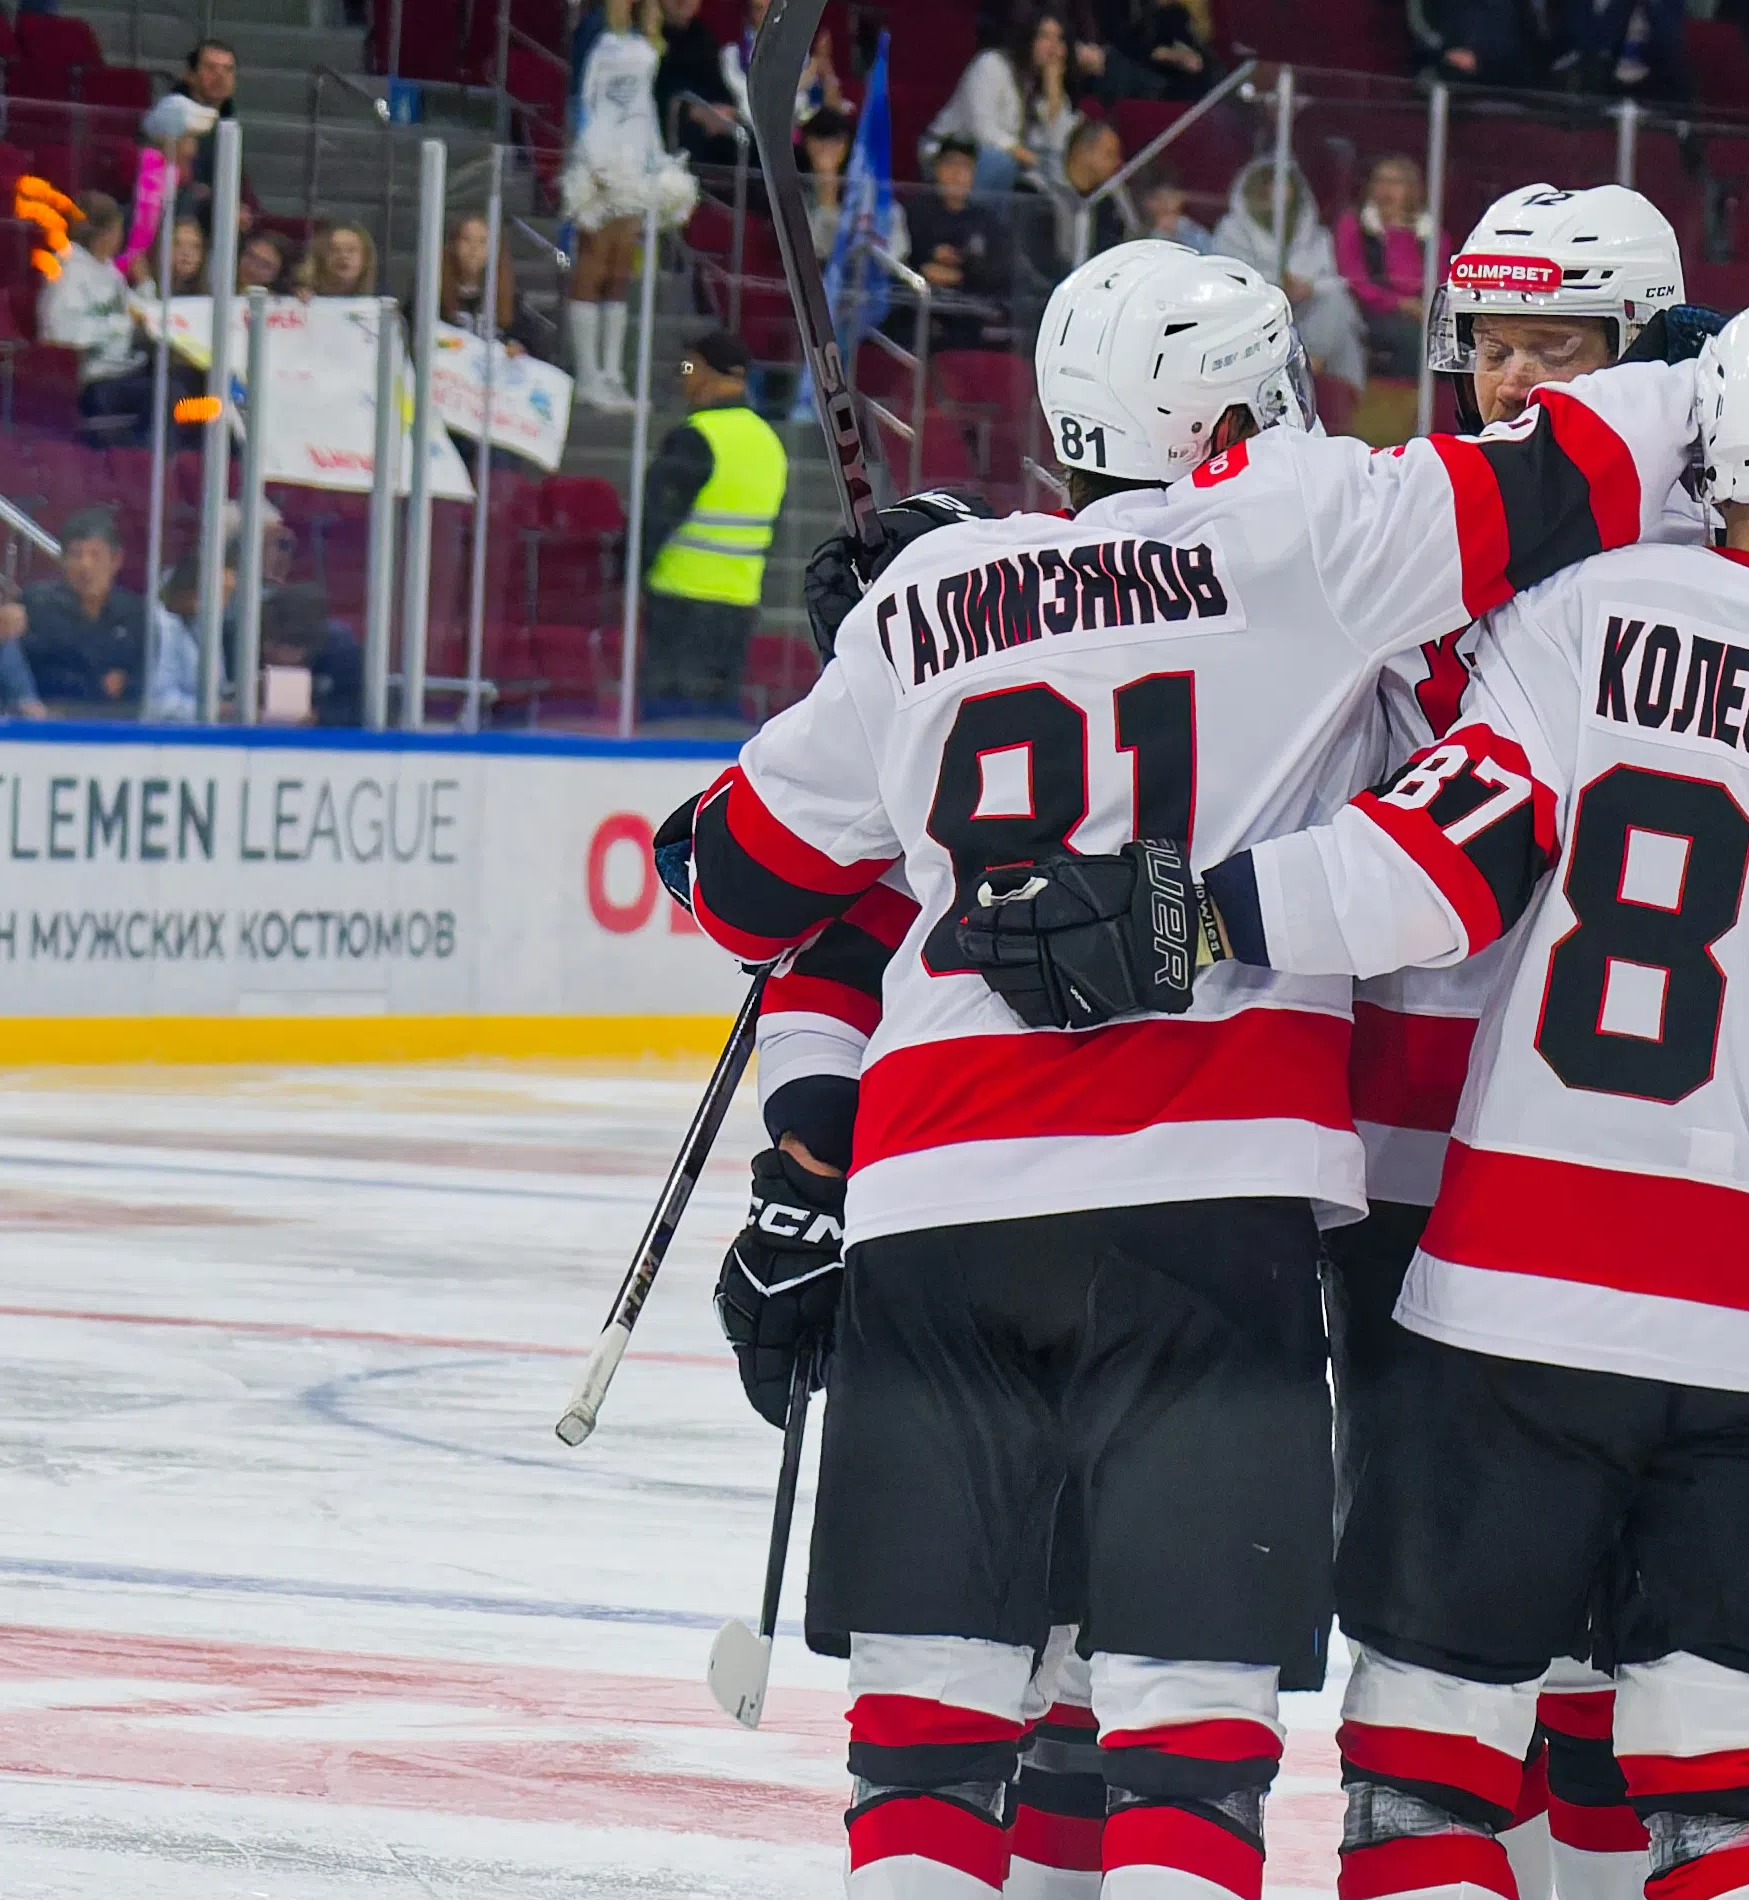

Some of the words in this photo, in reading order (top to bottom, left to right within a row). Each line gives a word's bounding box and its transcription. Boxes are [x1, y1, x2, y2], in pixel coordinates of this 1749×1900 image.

[1455, 262, 1554, 283] OLIMPBET
[1645, 285, 1675, 298] CCM
[1059, 416, 1107, 469] 81
[875, 540, 1229, 696] ГАЛИМЗЯНОВ
[238, 777, 458, 865] LEAGUE
[920, 669, 1197, 977] 81
[1376, 742, 1533, 846] 87
[31, 910, 225, 962] МУЖСКИХ
[239, 910, 458, 961] КОСТЮМОВ
